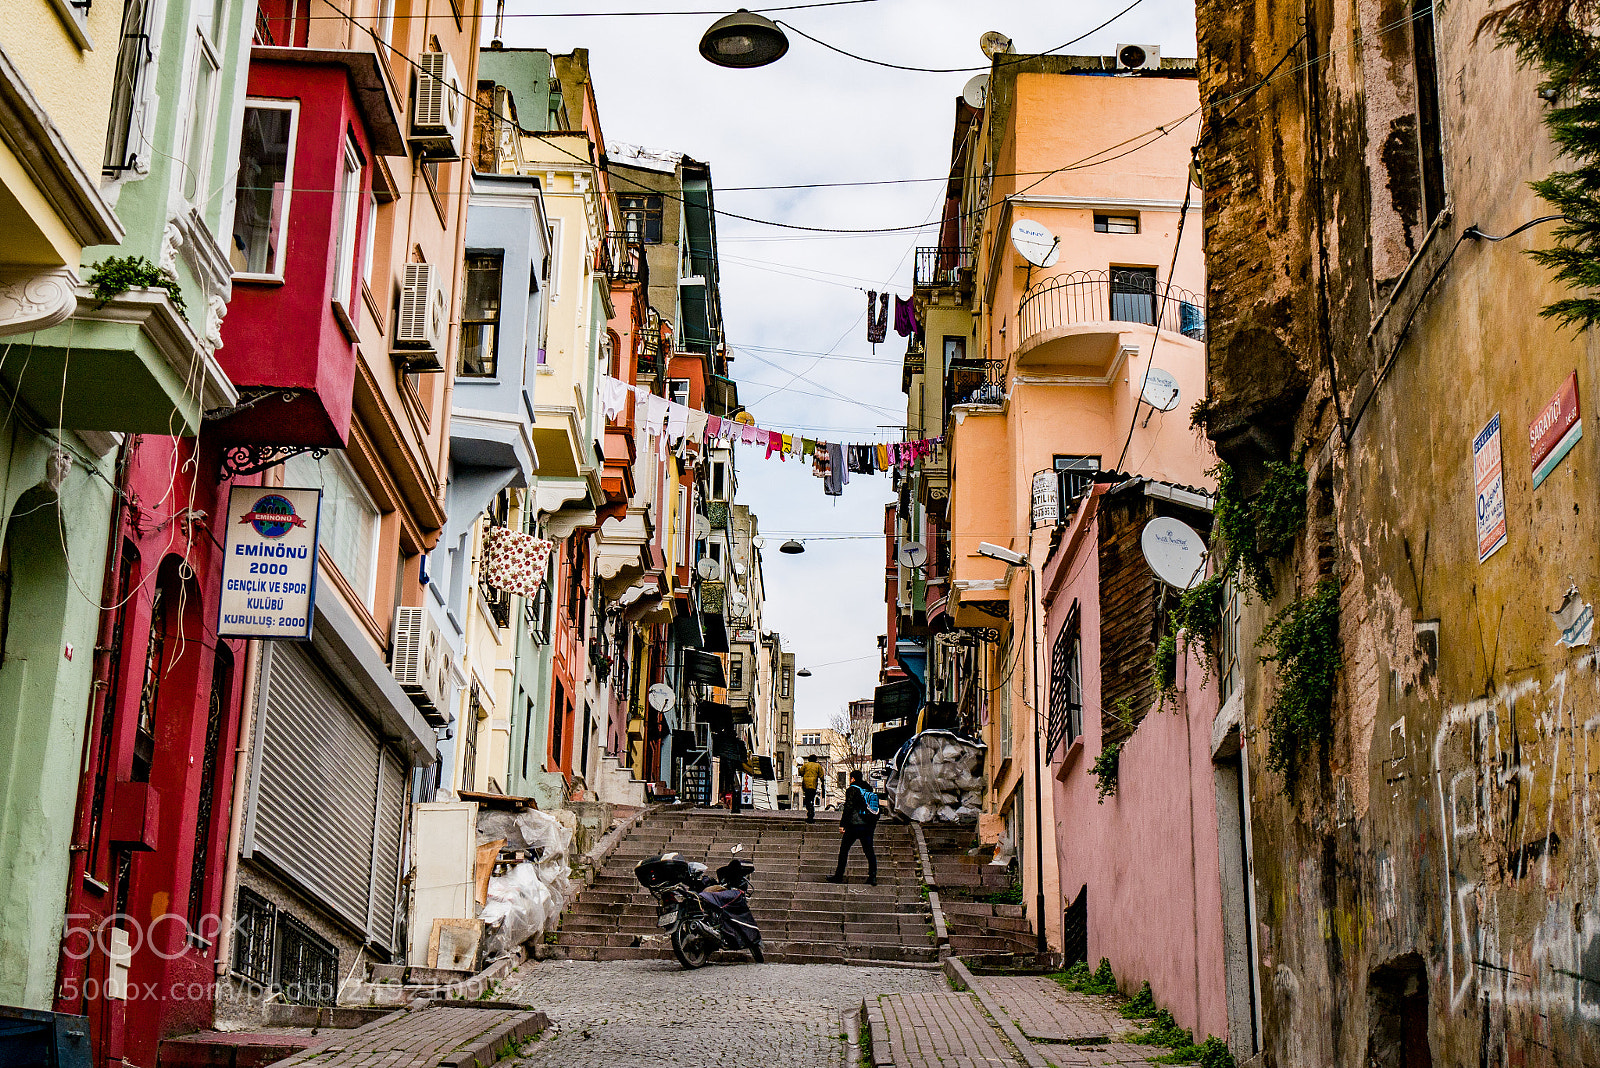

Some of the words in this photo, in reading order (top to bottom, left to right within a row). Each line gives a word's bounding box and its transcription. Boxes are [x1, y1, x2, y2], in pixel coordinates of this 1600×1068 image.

[1530, 393, 1561, 449] SARAYİÇİ
[255, 513, 293, 522] EMİNÖNÜ
[235, 542, 308, 559] EMİNÖNÜ
[249, 562, 288, 576] 2000
[227, 578, 266, 595] GENÇLİK
[268, 581, 280, 593] VE
[282, 583, 307, 595] SPOR
[247, 597, 284, 611] KULÜBÜ
[224, 614, 276, 628] KURULUŞ:
[278, 617, 305, 628] 2000
